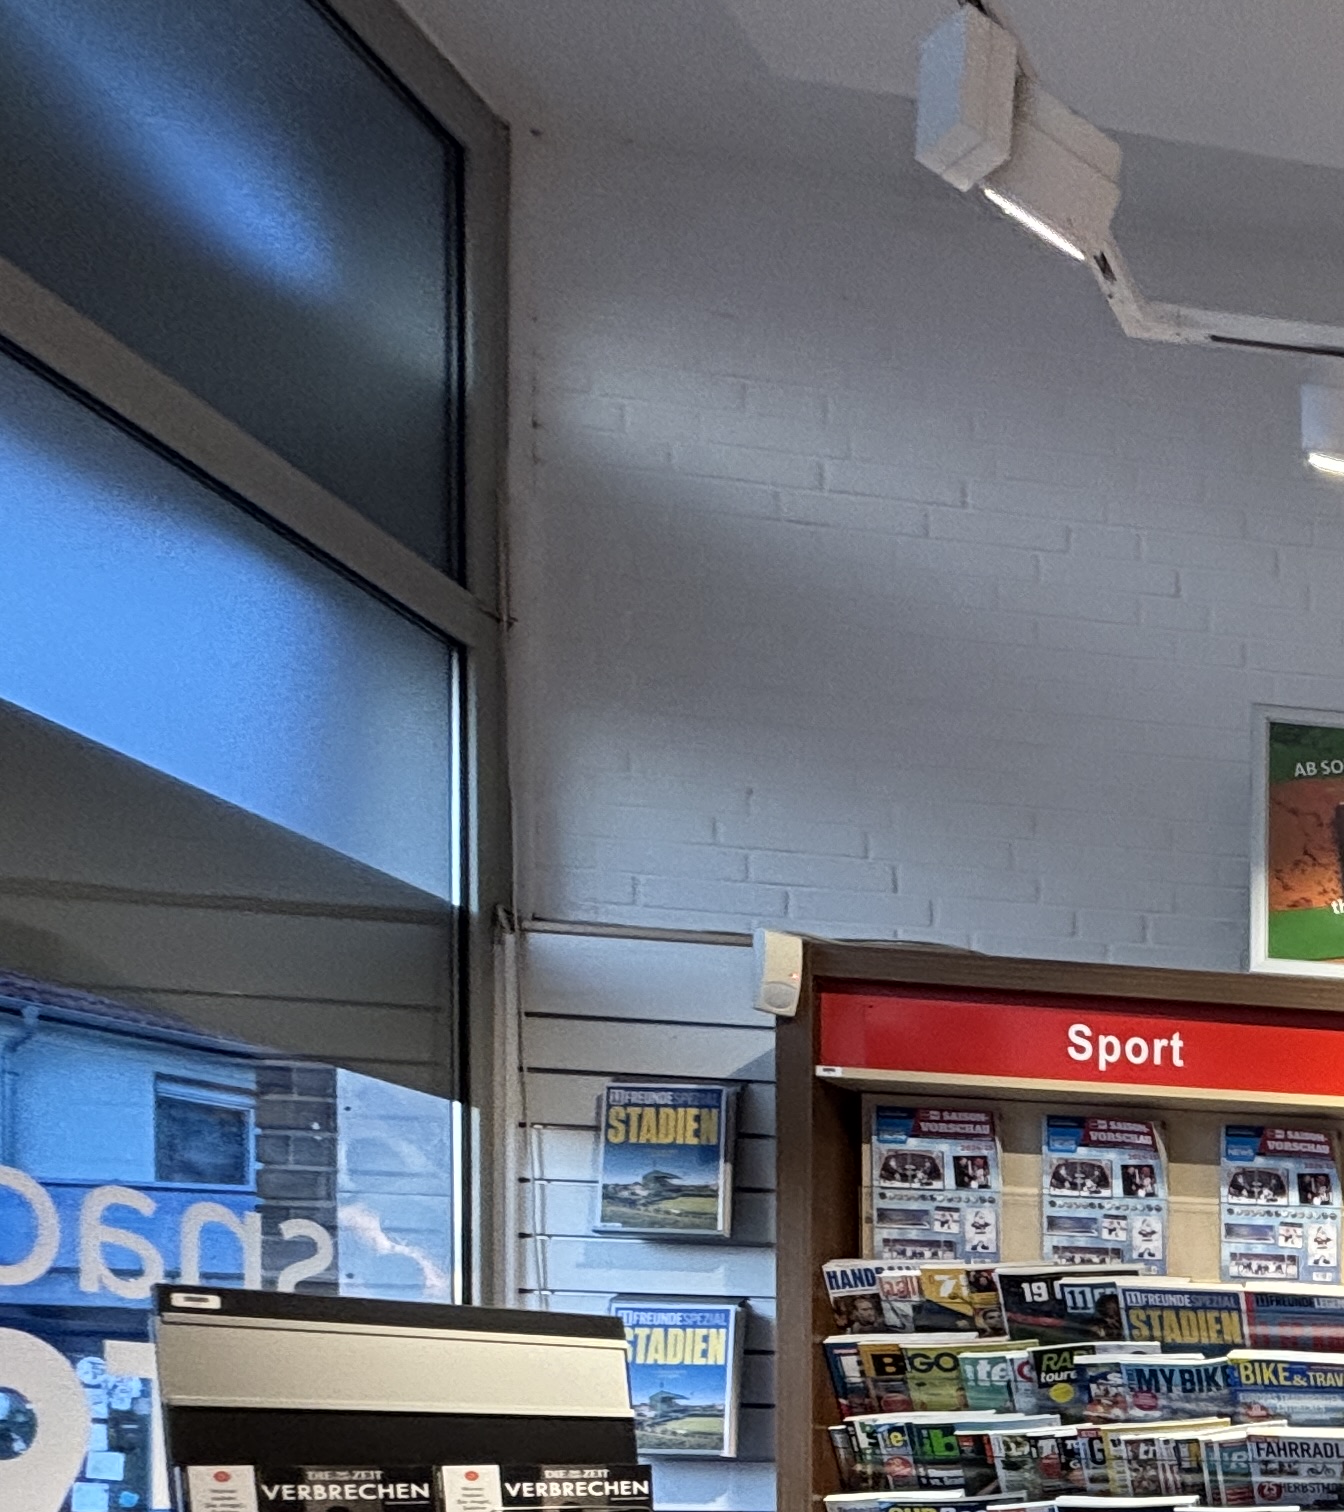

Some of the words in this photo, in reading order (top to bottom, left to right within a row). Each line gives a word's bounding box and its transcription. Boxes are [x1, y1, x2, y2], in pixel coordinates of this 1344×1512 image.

[1294, 760, 1319, 778] AB
[1066, 1024, 1186, 1071] Sport
[606, 1105, 719, 1147] STADIEN
[1129, 1308, 1243, 1345] STADIEN
[1239, 1361, 1290, 1386] BIKE
[260, 1481, 431, 1501] VERBRECHEN
[503, 1479, 649, 1498] VERBRECHEN
